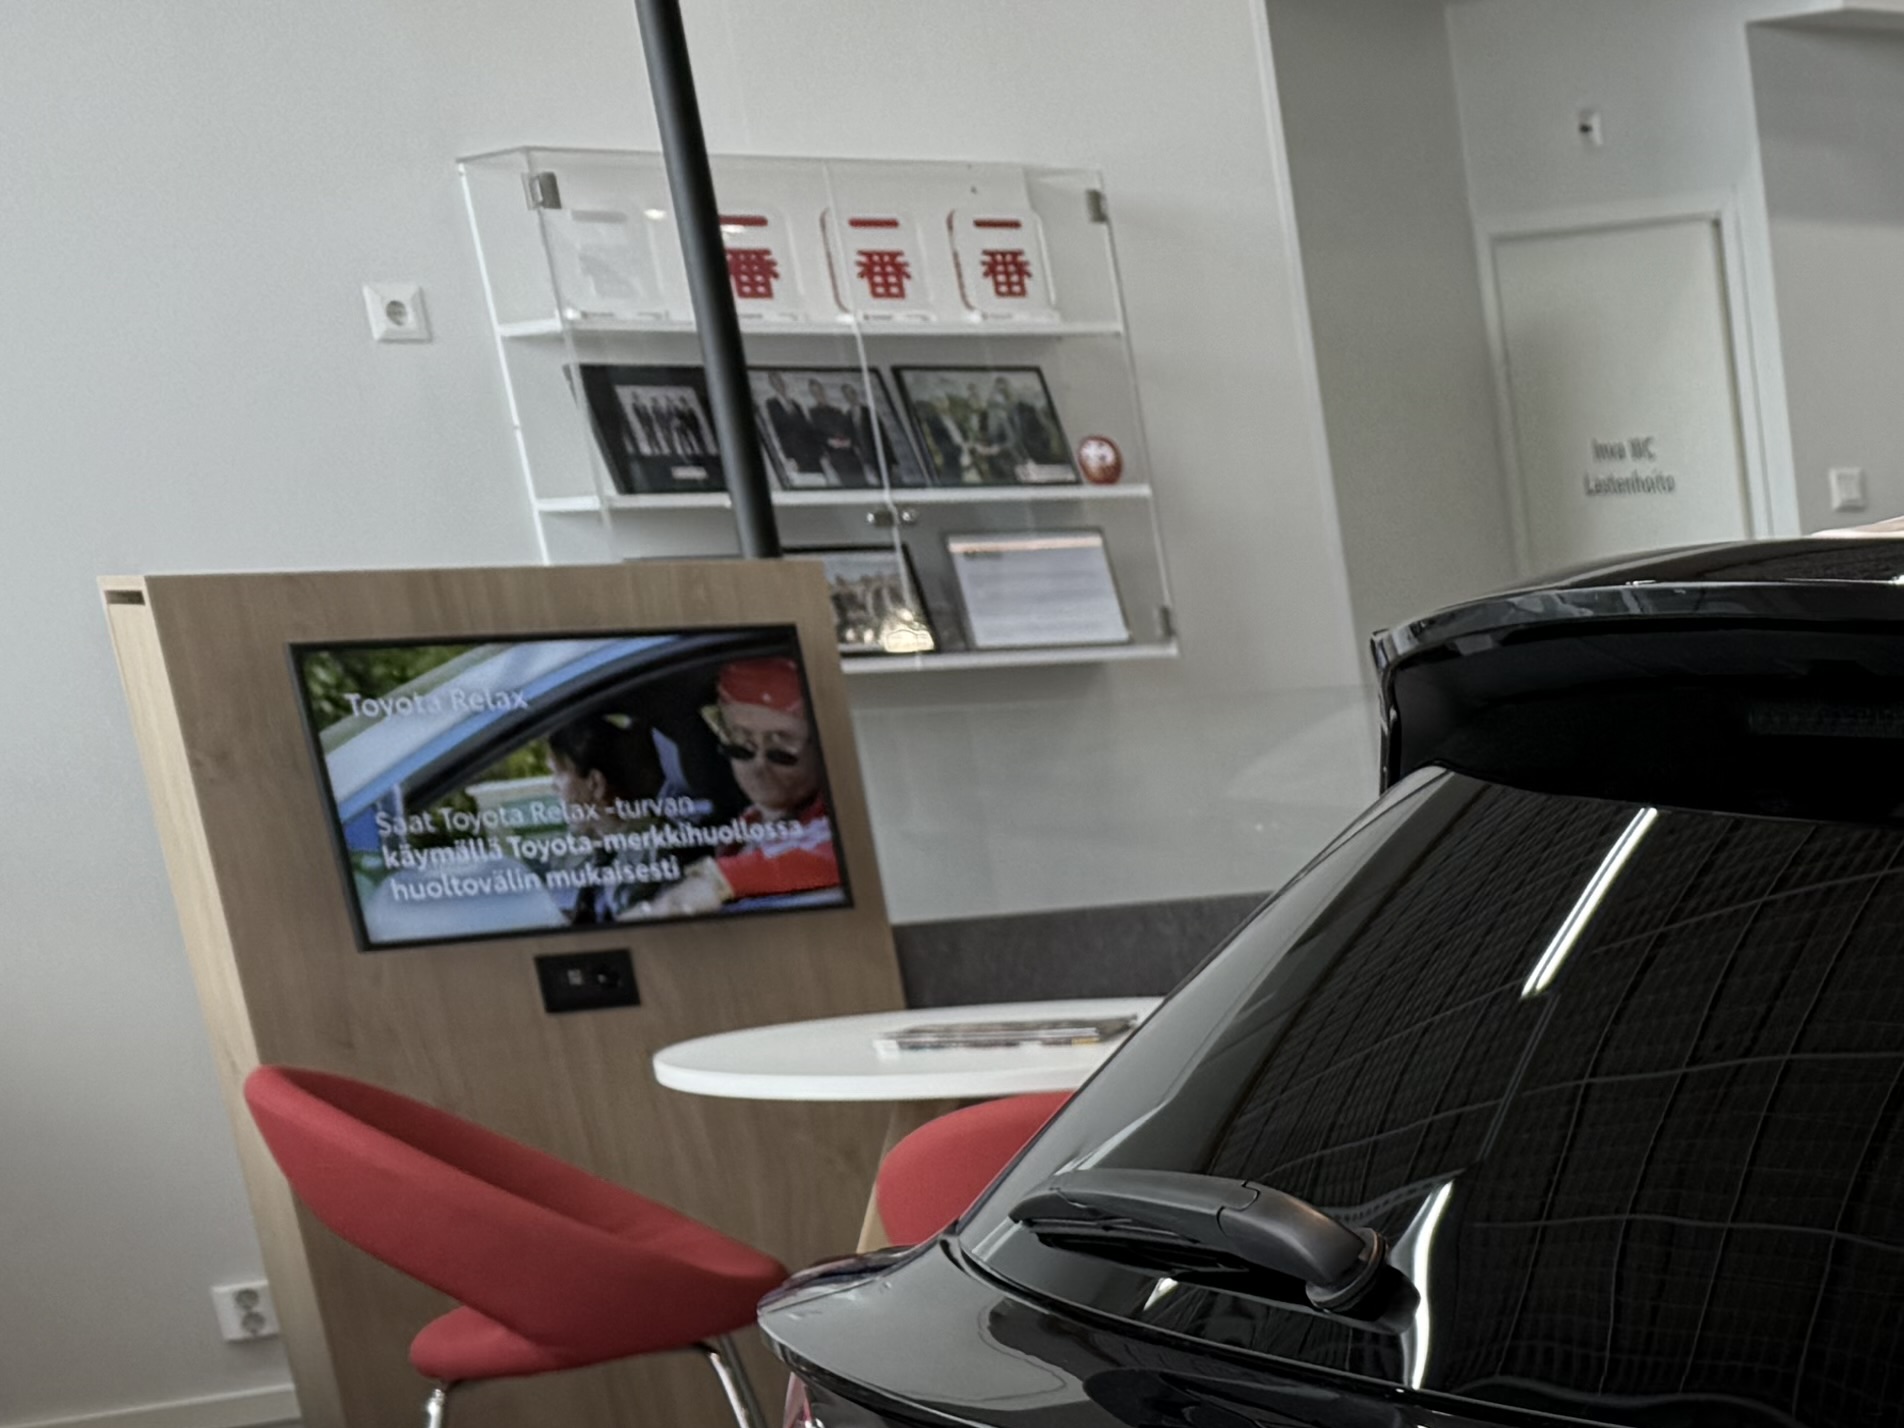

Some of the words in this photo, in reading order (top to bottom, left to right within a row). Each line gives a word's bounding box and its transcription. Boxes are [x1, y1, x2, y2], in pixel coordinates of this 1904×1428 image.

[344, 691, 442, 720] Toyota
[452, 687, 529, 713] Relax
[375, 810, 436, 837] Saat
[439, 804, 523, 835] Toyota
[531, 800, 599, 824] Relax
[605, 795, 696, 820] -turvan
[382, 836, 503, 871] käymällä
[506, 817, 805, 863] Toyota-merkkihuollossa
[390, 868, 541, 901] huoltovälin
[546, 855, 682, 888] mukaisesti
